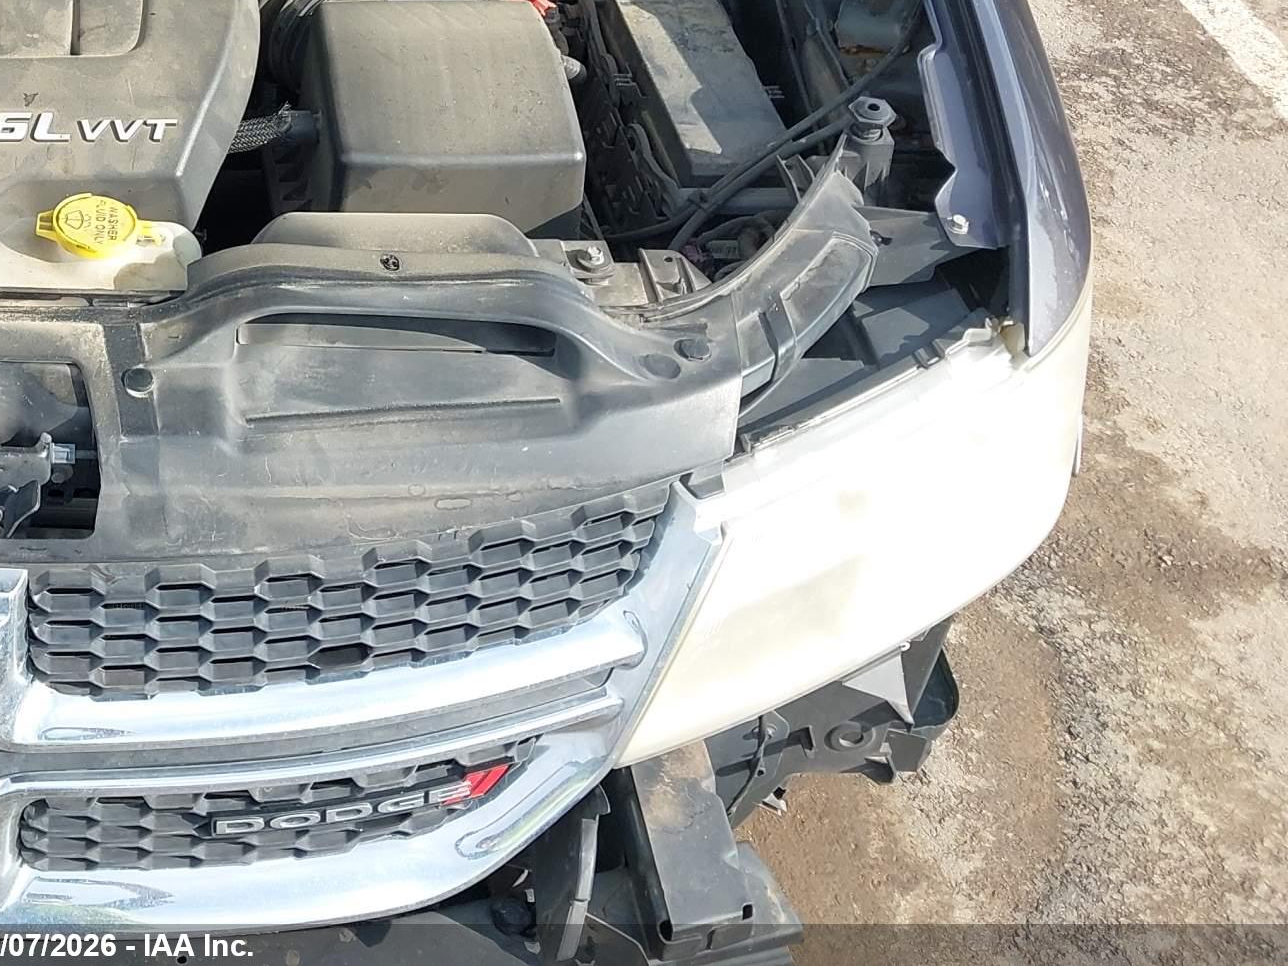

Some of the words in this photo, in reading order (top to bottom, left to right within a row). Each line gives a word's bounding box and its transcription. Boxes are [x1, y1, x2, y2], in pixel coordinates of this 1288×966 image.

[77, 118, 178, 143] VVT
[95, 199, 107, 222] FLUID
[94, 223, 106, 245] ONLY
[107, 206, 119, 241] WASHER
[215, 781, 472, 835] DODGE
